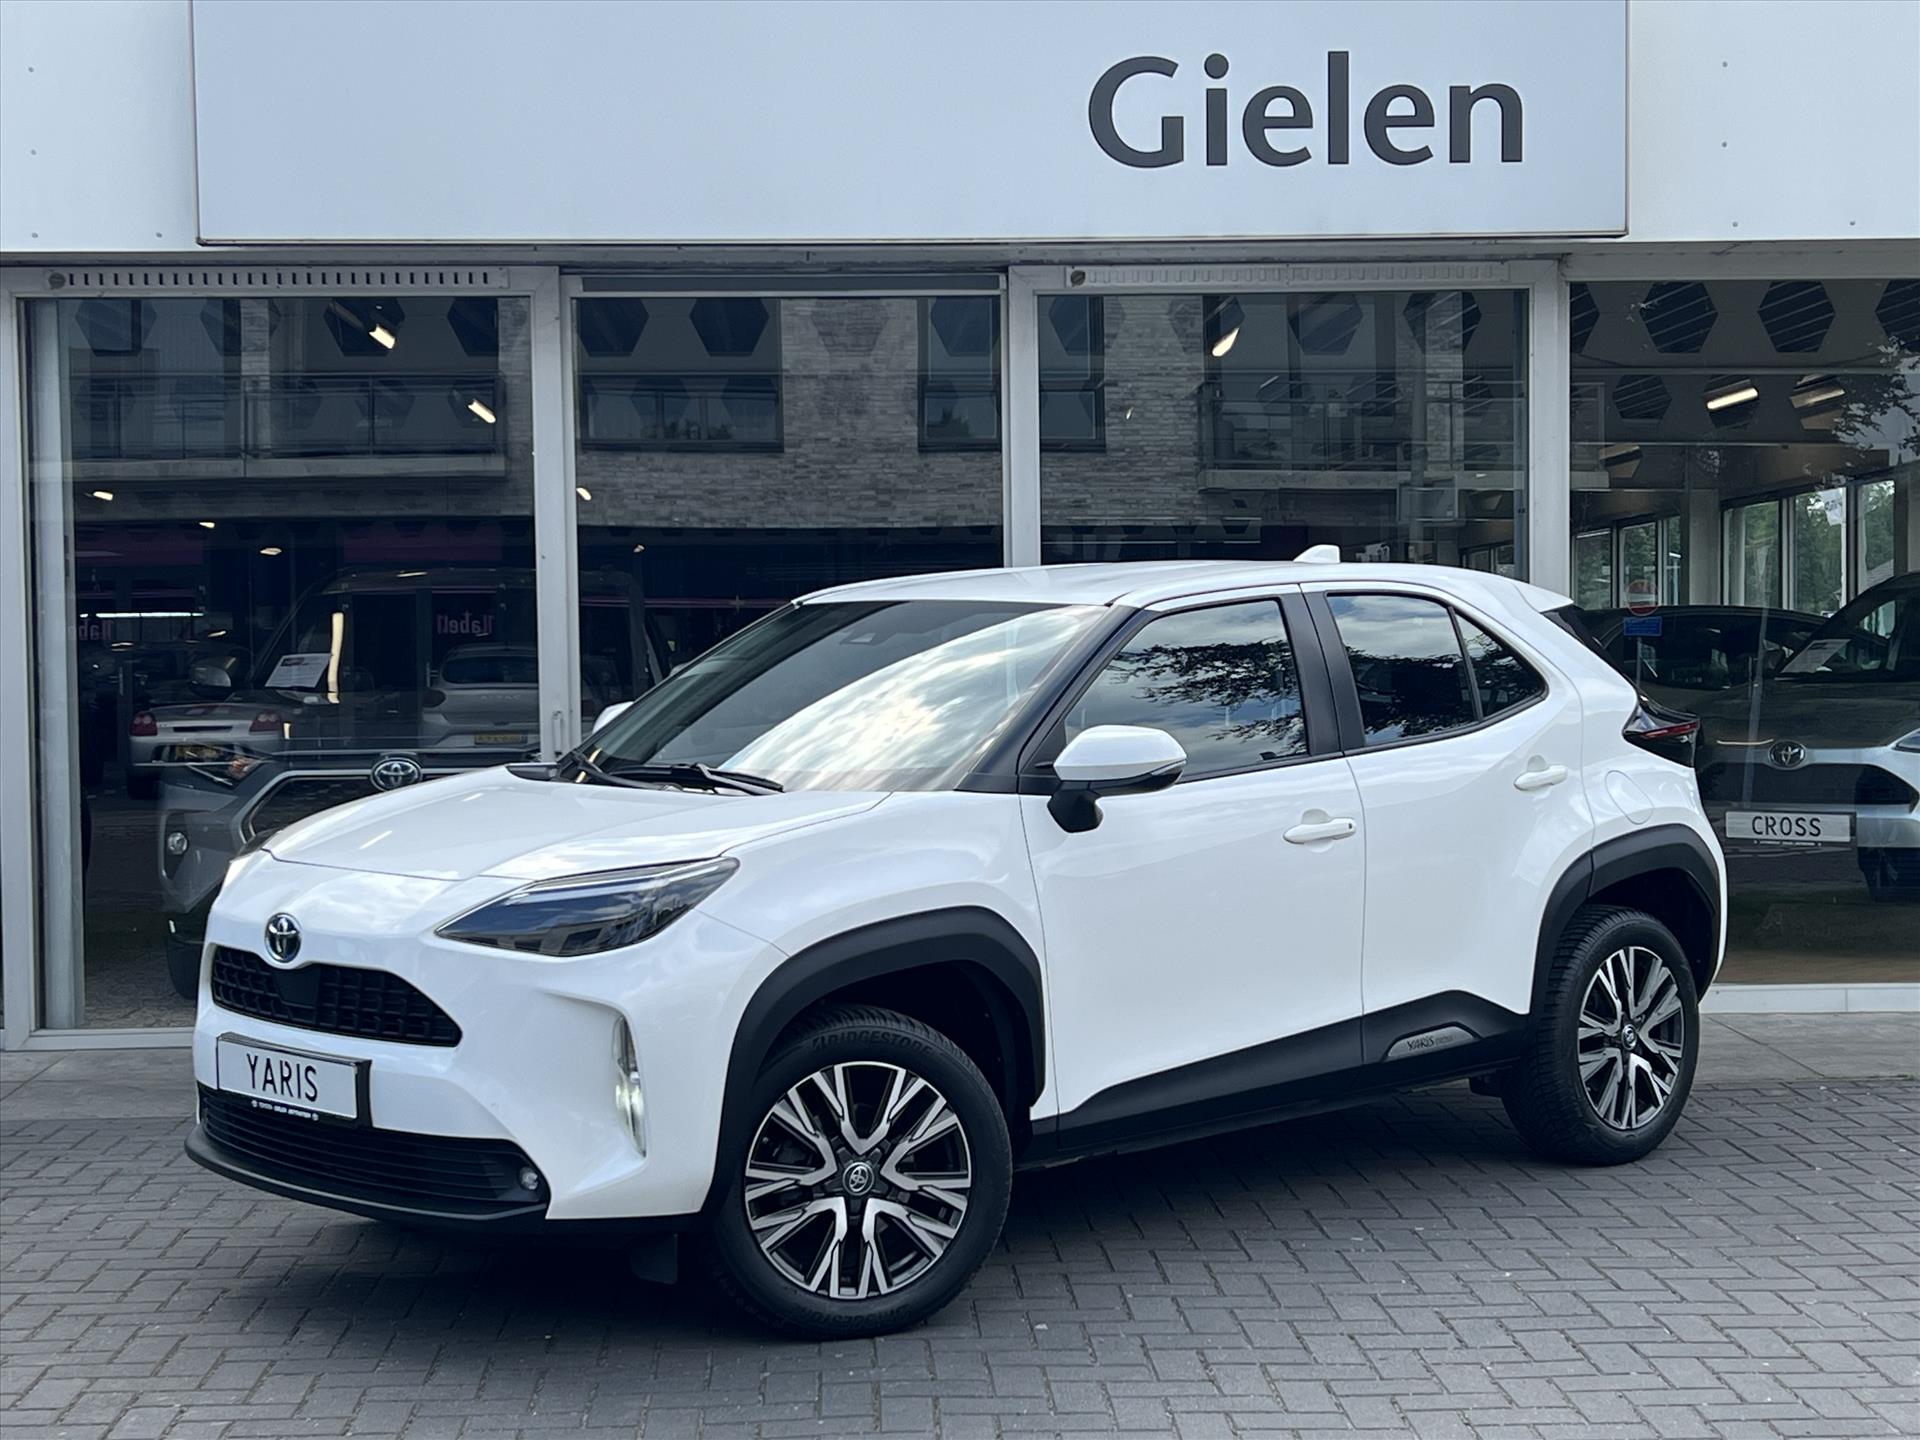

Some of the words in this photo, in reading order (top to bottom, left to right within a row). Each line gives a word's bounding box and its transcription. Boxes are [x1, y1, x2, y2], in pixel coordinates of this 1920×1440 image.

[1088, 50, 1523, 168] Gielen
[1752, 816, 1821, 837] CROSS
[246, 1053, 318, 1102] YARIS
